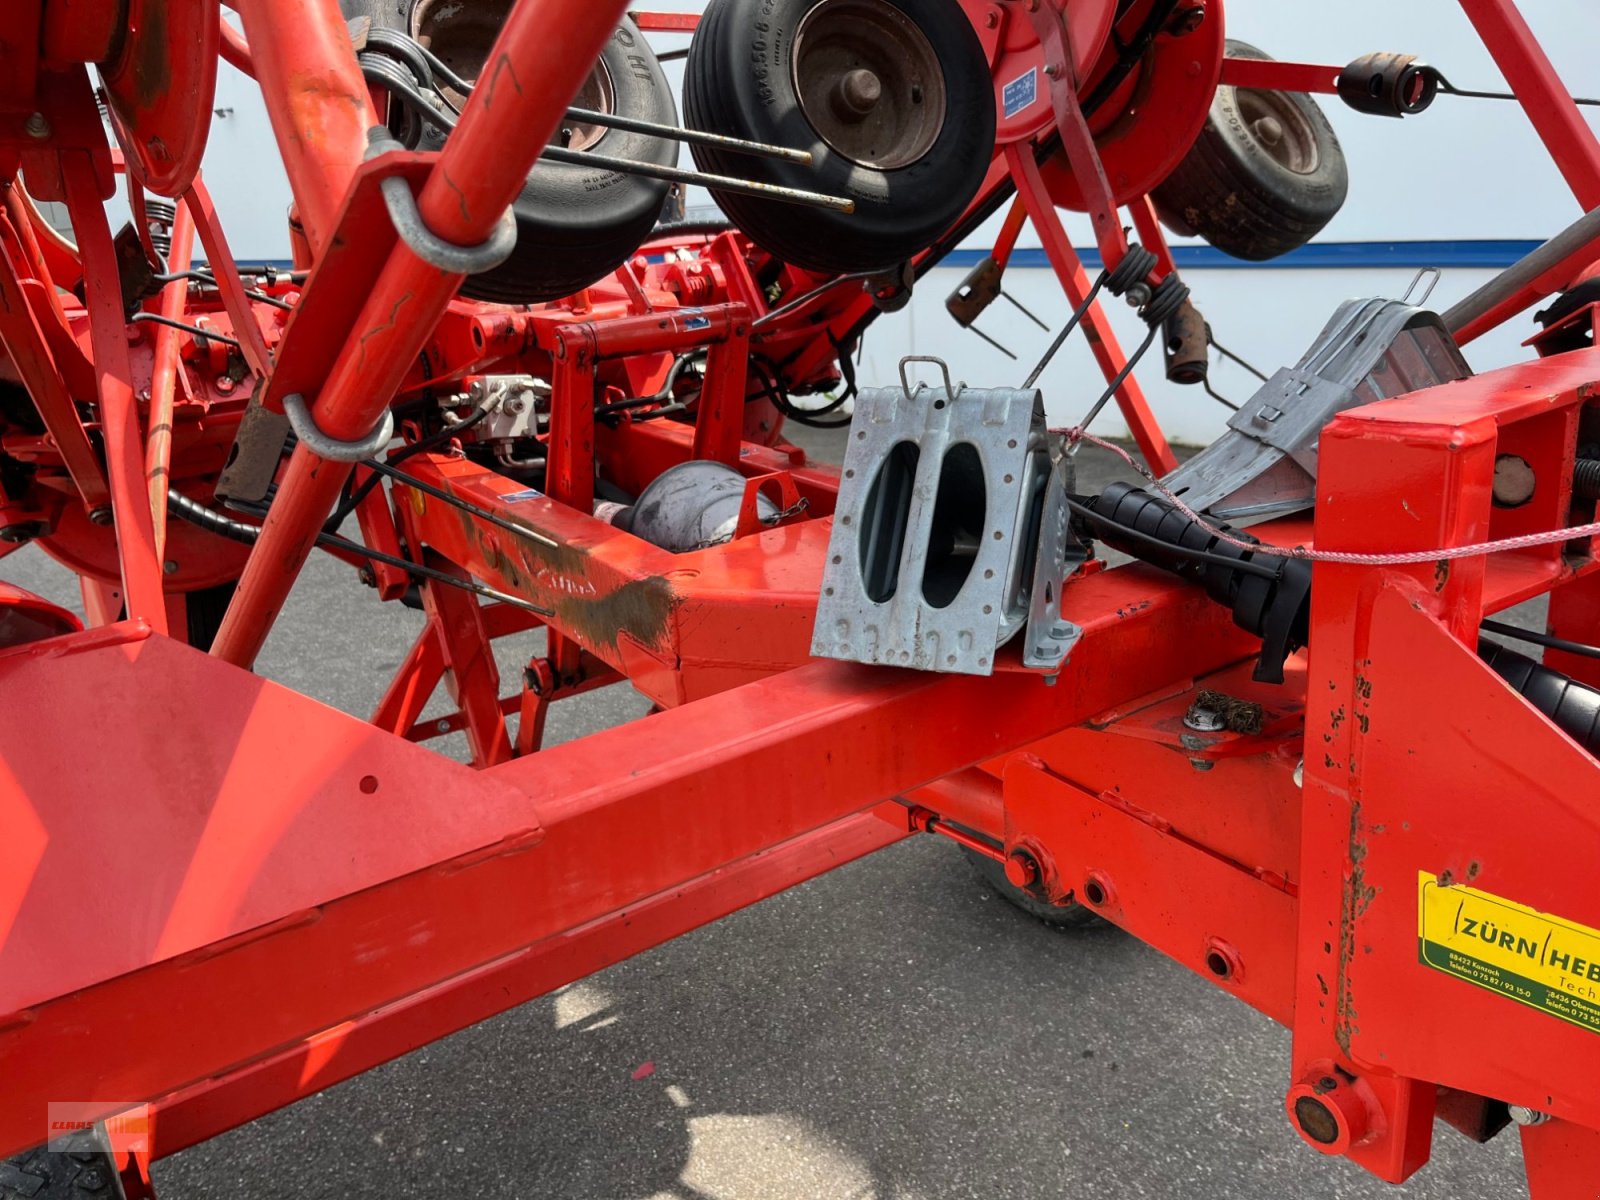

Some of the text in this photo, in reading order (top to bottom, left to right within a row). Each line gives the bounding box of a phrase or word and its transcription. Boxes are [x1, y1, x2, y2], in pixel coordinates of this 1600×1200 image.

[1461, 917, 1538, 959] ZÜRN
[1449, 961, 1472, 975] Telefon
[1546, 998, 1570, 1013] Telefon
